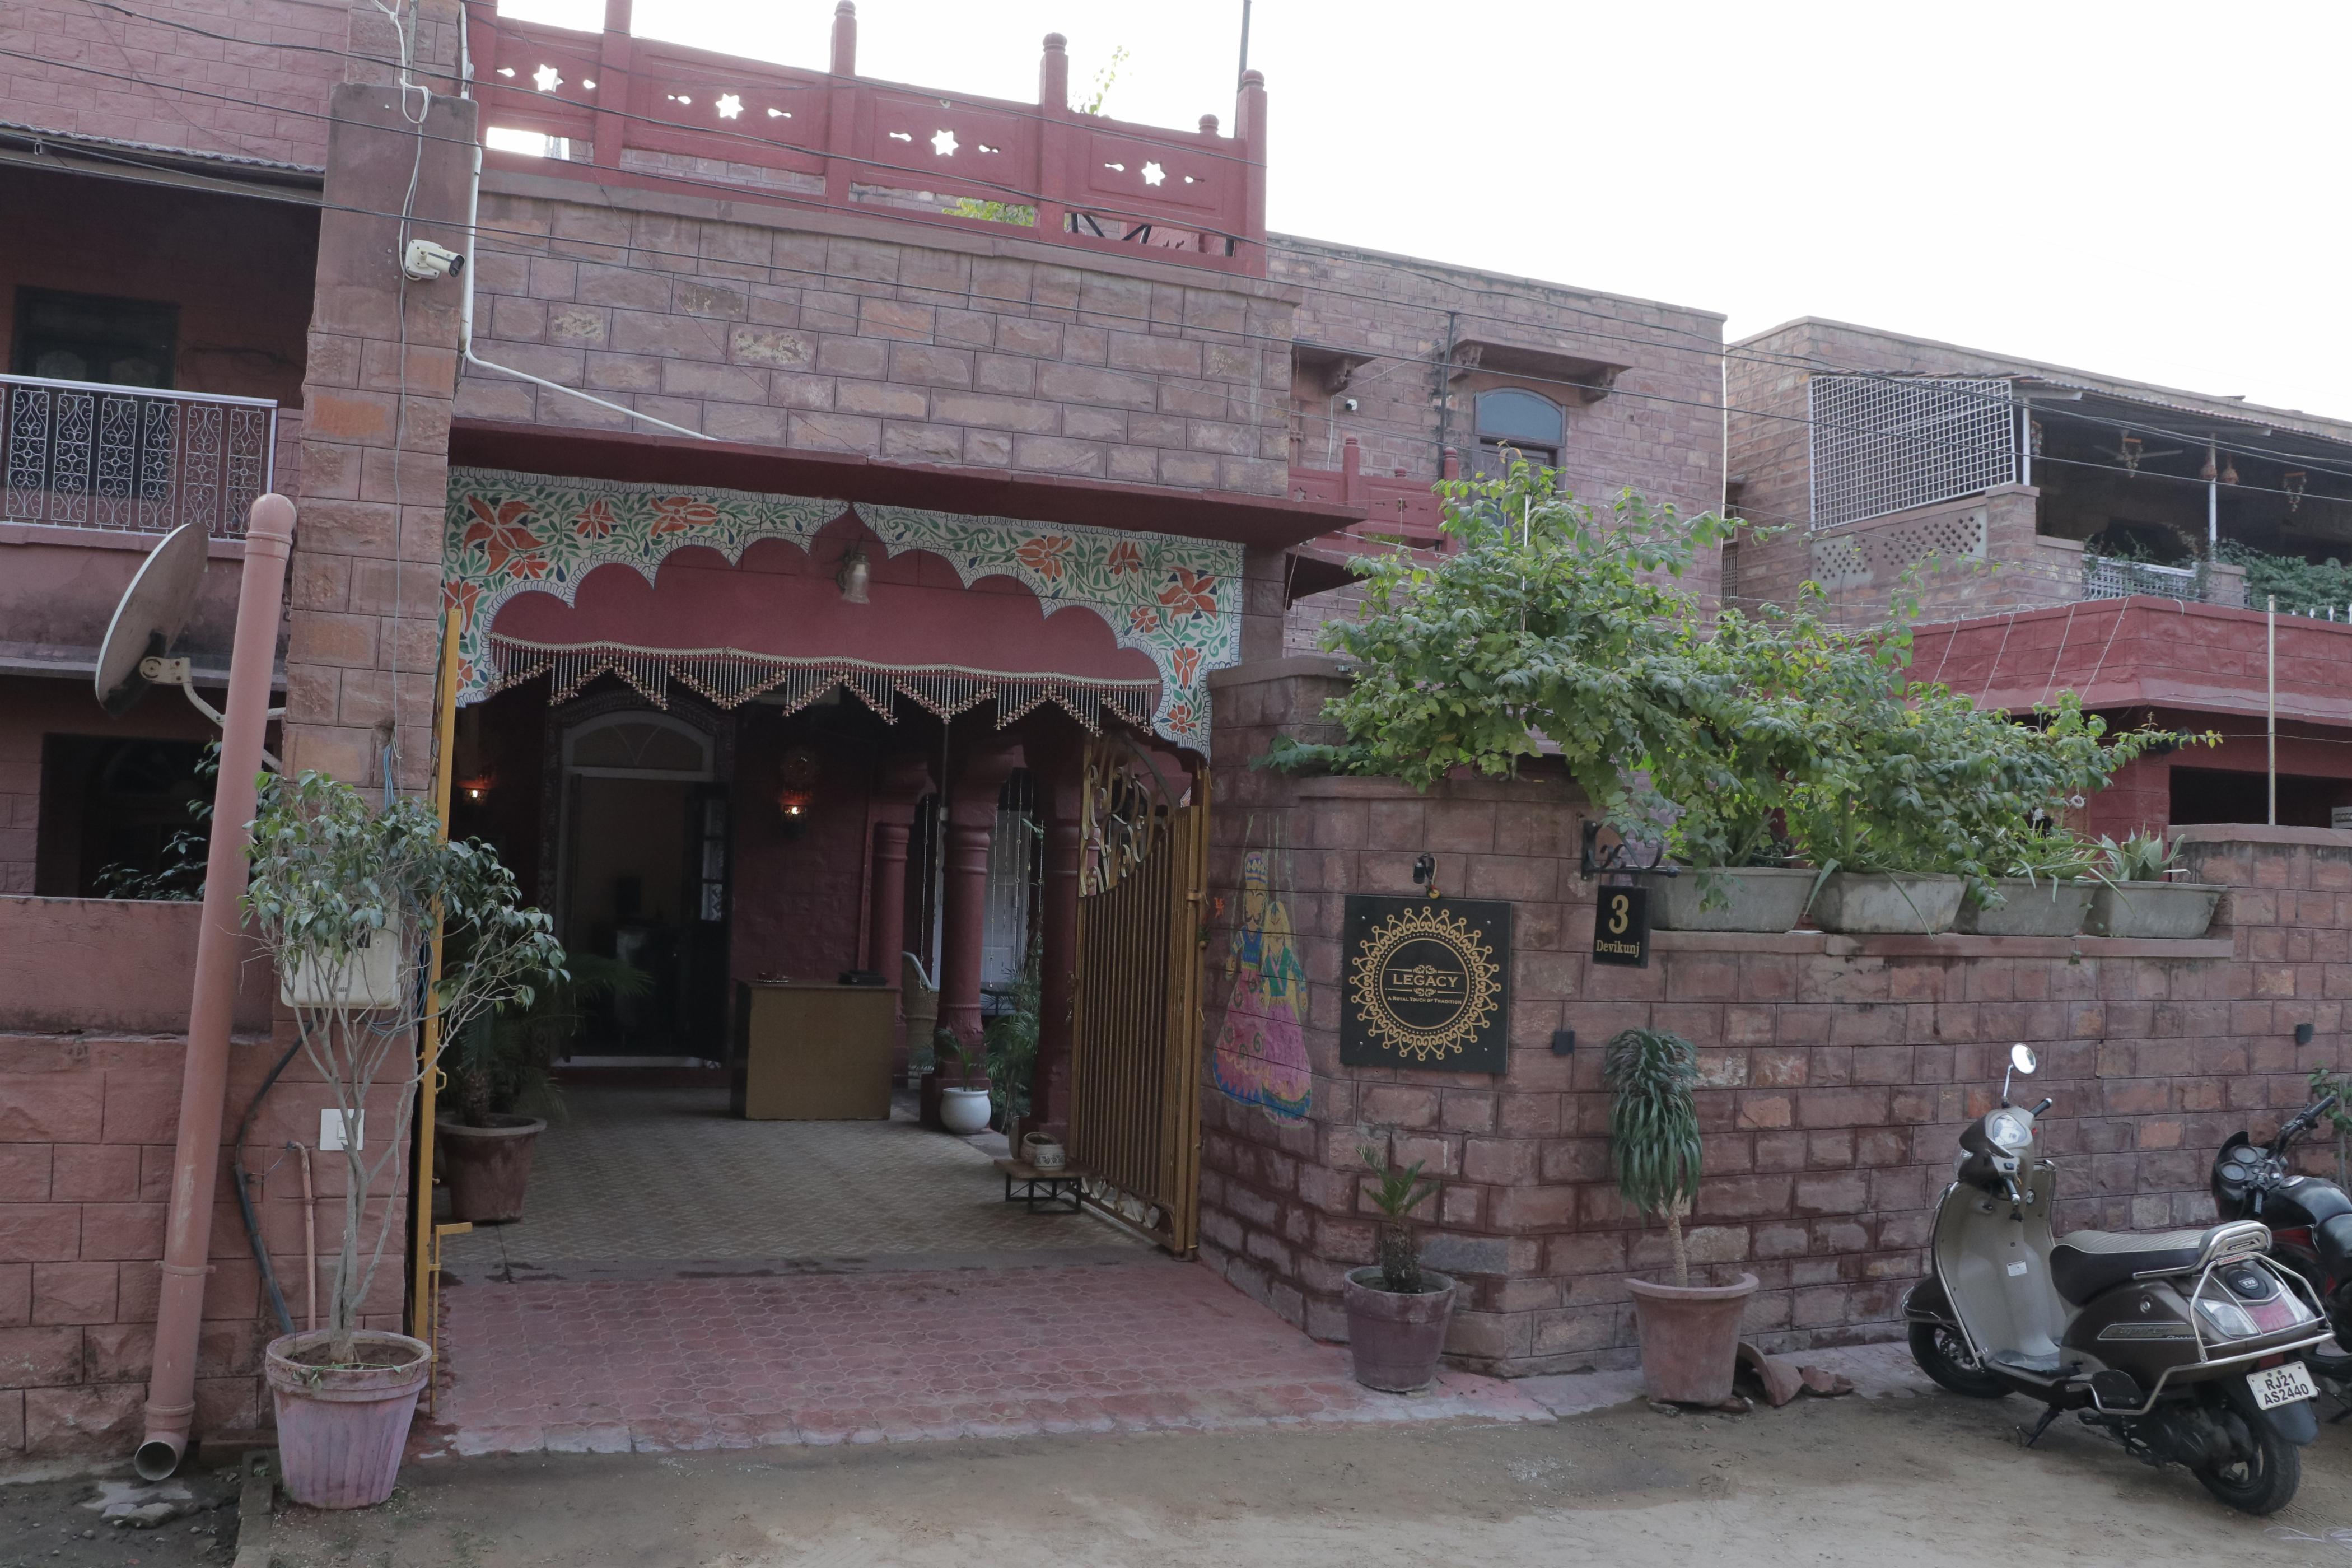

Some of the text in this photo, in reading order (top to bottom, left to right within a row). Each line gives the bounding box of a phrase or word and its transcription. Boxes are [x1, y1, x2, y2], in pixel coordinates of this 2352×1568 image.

[1609, 895, 1629, 934] 3
[1596, 940, 1640, 958] Devikunj
[1393, 974, 1458, 987] LEGACY
[2265, 1373, 2296, 1390] RJ21
[2264, 1383, 2309, 1405] AS2440
